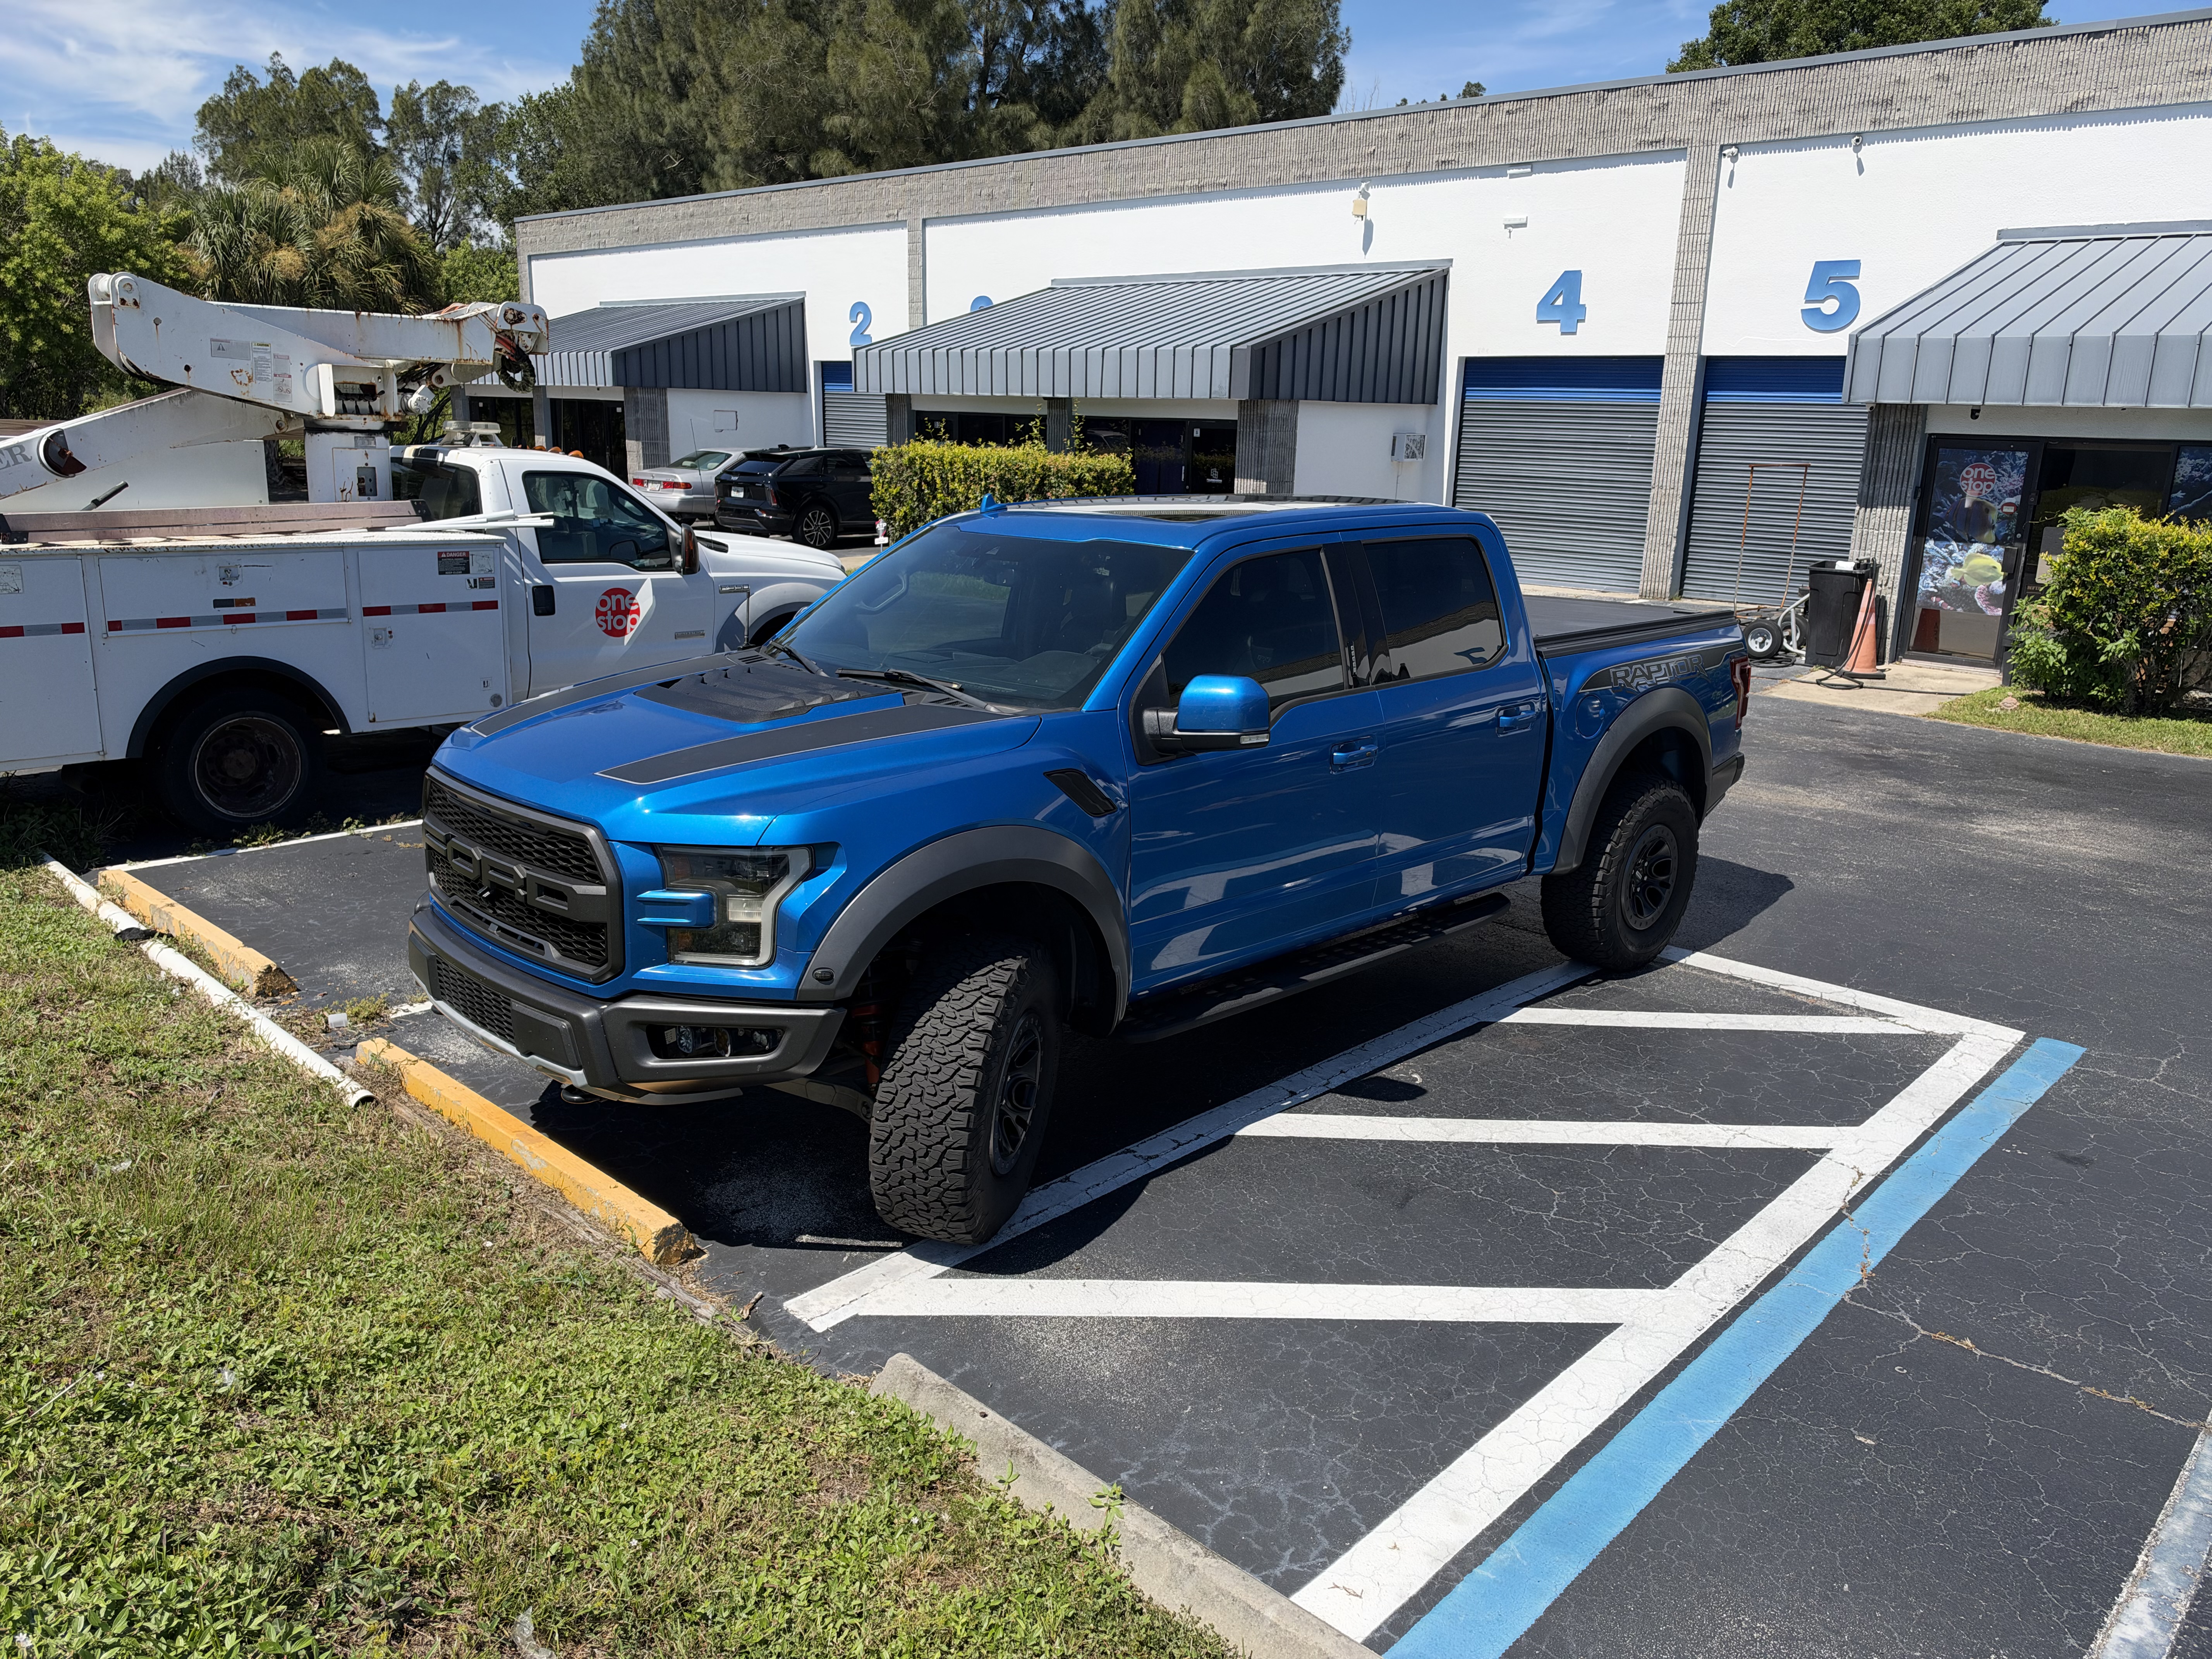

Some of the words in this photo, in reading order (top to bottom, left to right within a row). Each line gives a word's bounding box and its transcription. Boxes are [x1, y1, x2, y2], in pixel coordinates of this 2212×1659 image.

[1536, 270, 1586, 335] 4
[1801, 259, 1861, 331] 5
[850, 301, 872, 345] 2
[1961, 477, 1994, 494] stop
[1963, 467, 1995, 479] one
[596, 594, 639, 611] one
[596, 611, 640, 634] stop
[1610, 654, 1708, 692] RAPTOR
[422, 815, 578, 920] FORD
